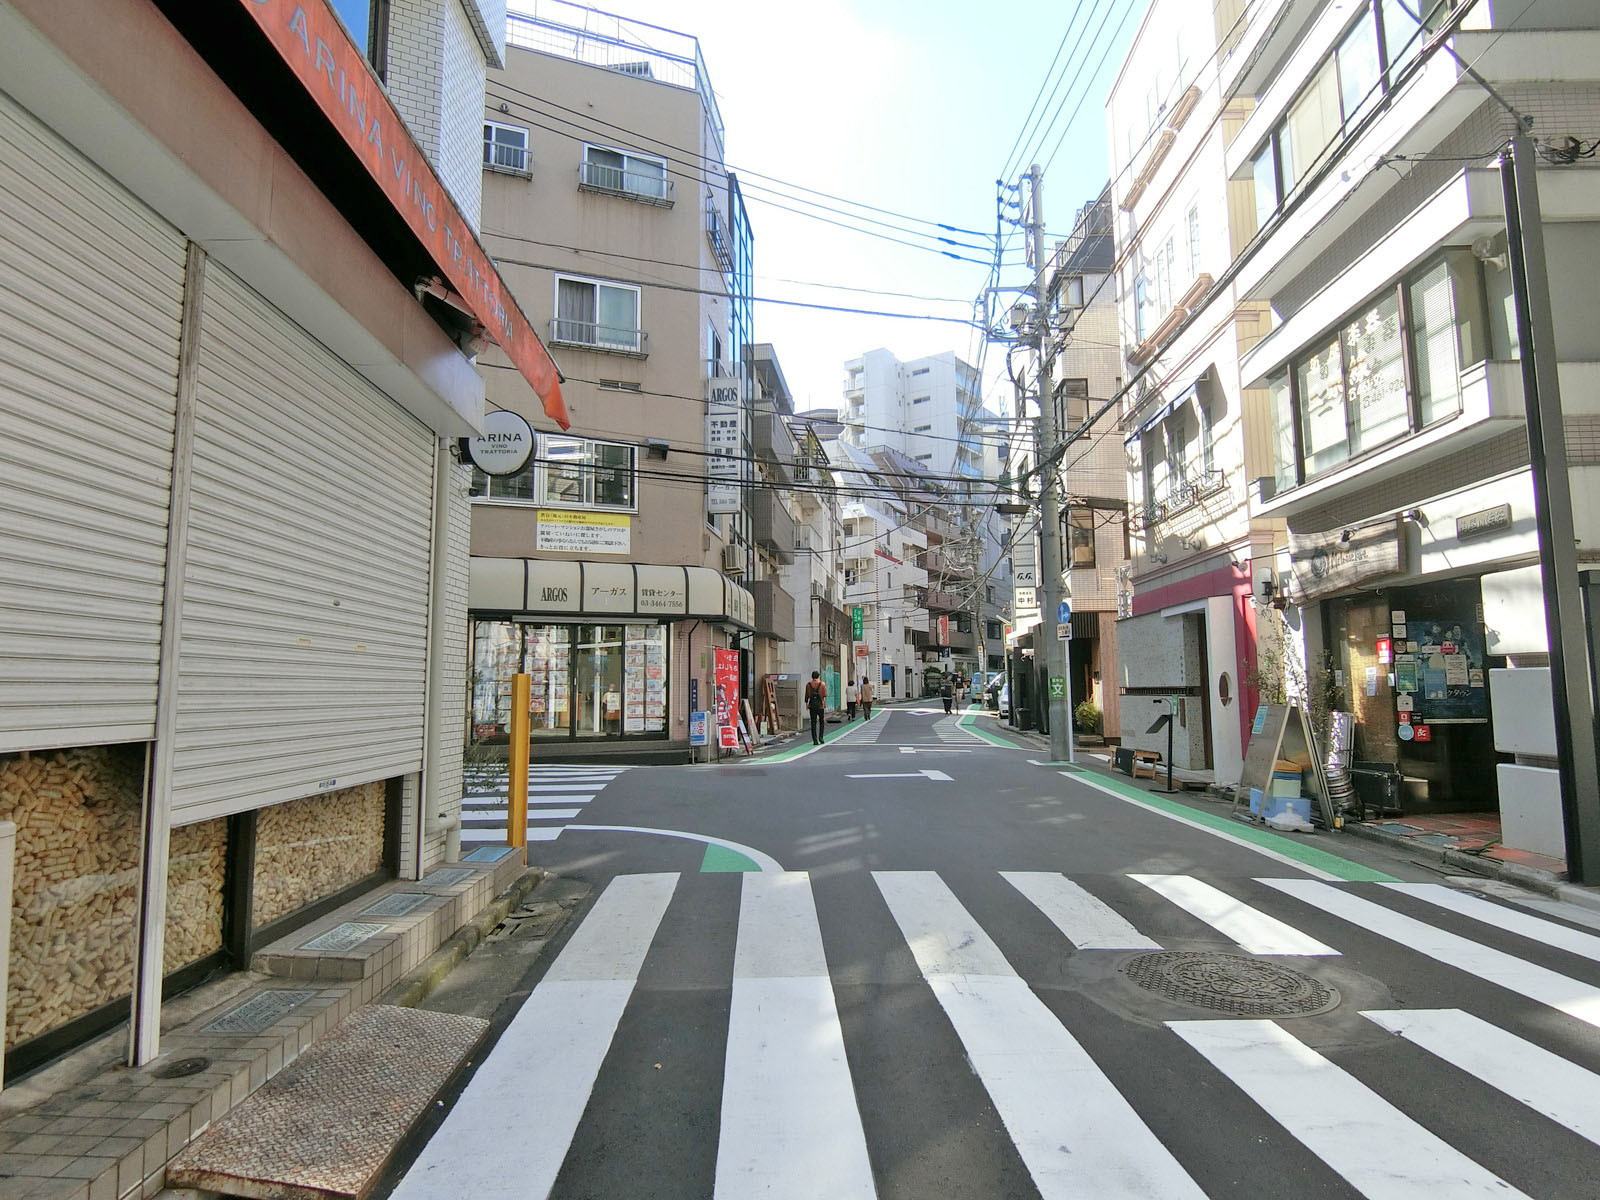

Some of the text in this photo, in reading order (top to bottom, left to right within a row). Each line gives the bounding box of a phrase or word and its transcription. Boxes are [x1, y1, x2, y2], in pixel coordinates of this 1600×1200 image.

[391, 148, 438, 233] VINO
[443, 226, 514, 342] TRATTORIA
[711, 387, 738, 402] ARGOS
[541, 588, 568, 602] ARGOS
[591, 587, 627, 596] アーガス
[641, 588, 684, 597] 賃貸センター
[1052, 684, 1064, 695] 文
